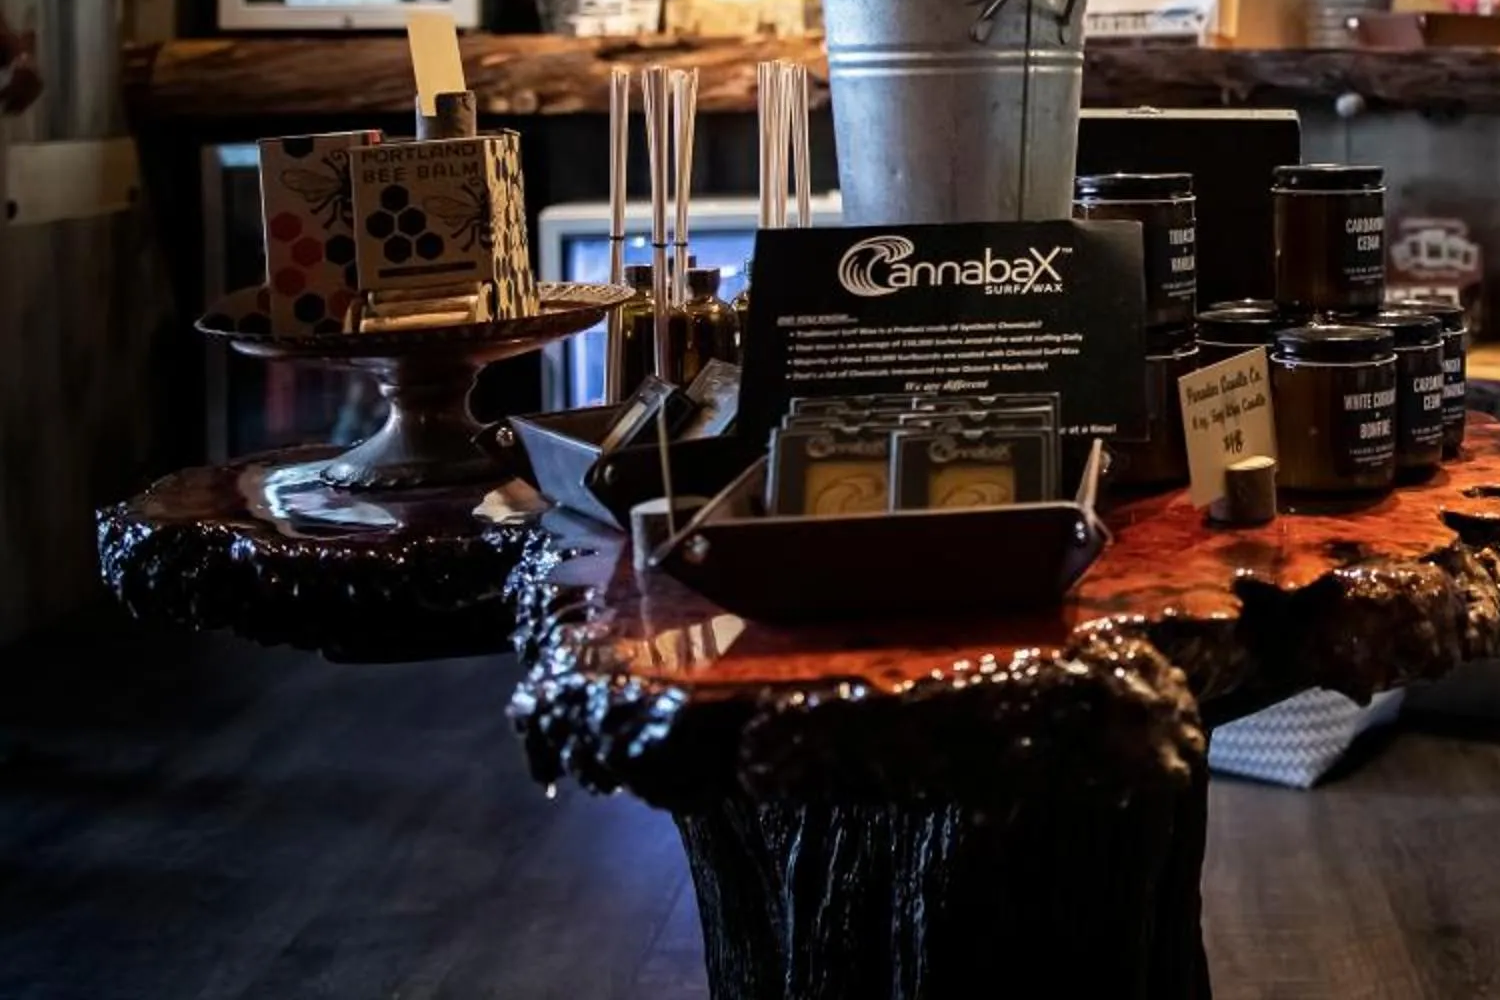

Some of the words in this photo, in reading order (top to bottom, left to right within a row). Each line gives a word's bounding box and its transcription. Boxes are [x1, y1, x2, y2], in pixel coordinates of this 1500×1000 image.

[362, 143, 477, 162] PORTLAND
[363, 167, 408, 183] BEE
[417, 161, 479, 178] BALM
[984, 284, 1021, 295] SURF
[1031, 283, 1064, 293] WAX
[942, 378, 989, 393] different
[1343, 393, 1372, 411] WHITE
